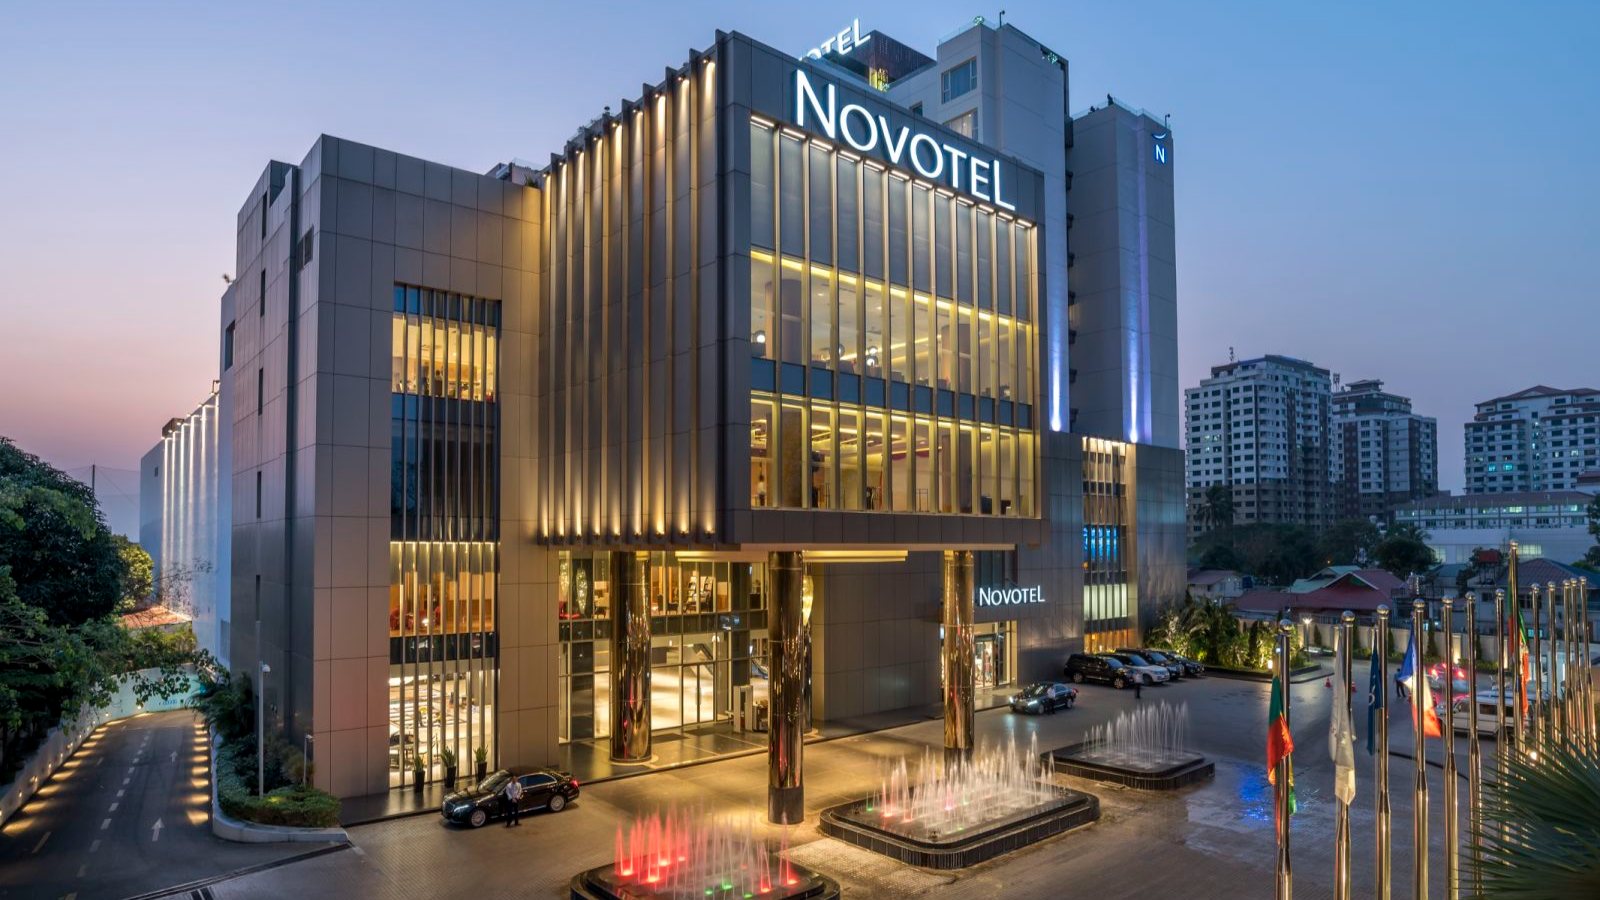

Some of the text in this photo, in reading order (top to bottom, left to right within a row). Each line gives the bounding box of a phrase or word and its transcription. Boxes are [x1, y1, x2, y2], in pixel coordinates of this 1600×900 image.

[799, 18, 871, 61] OTEL
[796, 69, 1016, 211] NOVOTEL
[1155, 144, 1165, 164] N
[979, 585, 1046, 607] NOVOTEL
